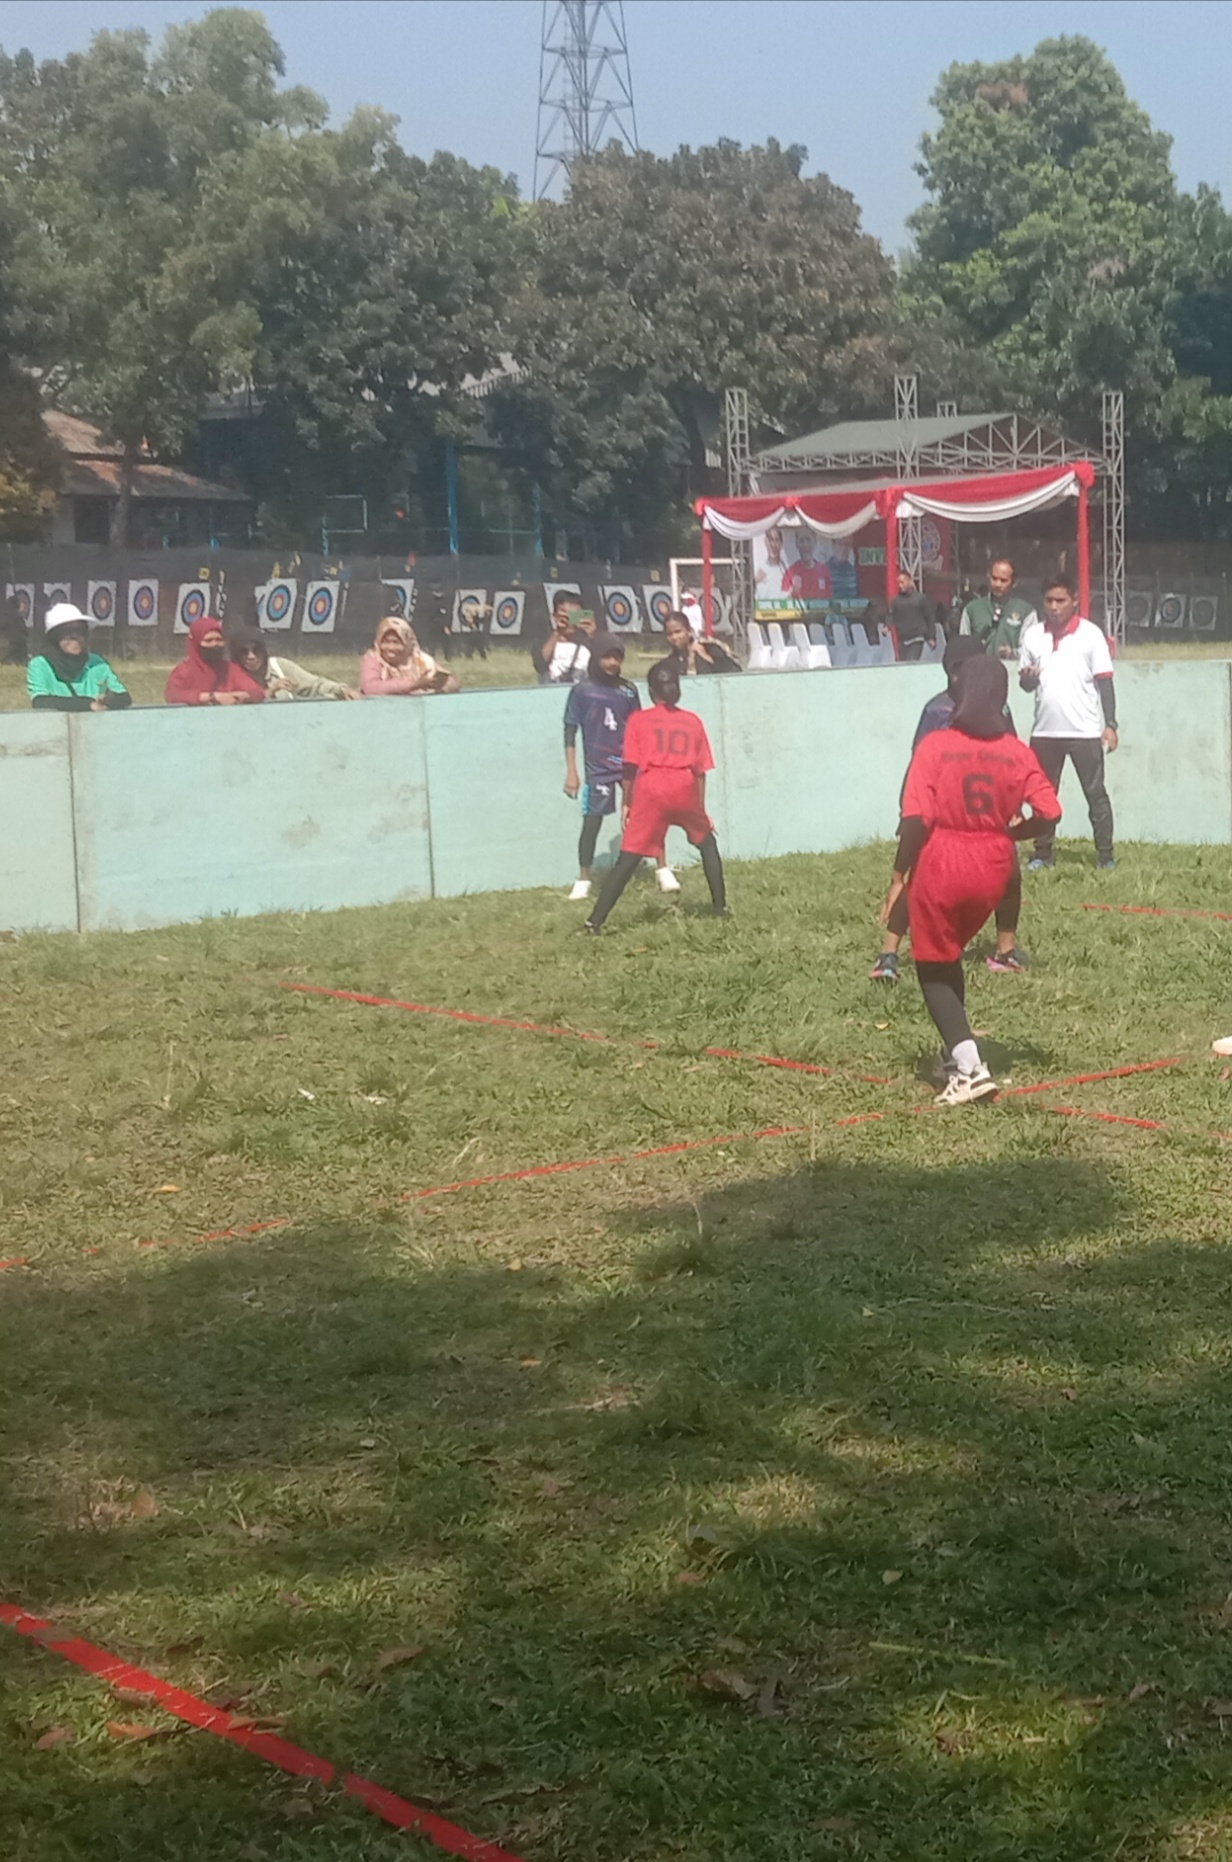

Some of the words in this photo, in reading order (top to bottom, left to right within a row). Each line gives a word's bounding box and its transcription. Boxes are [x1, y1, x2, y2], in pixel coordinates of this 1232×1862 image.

[604, 707, 617, 730] 4
[654, 729, 689, 754] 10
[962, 774, 994, 814] 6
